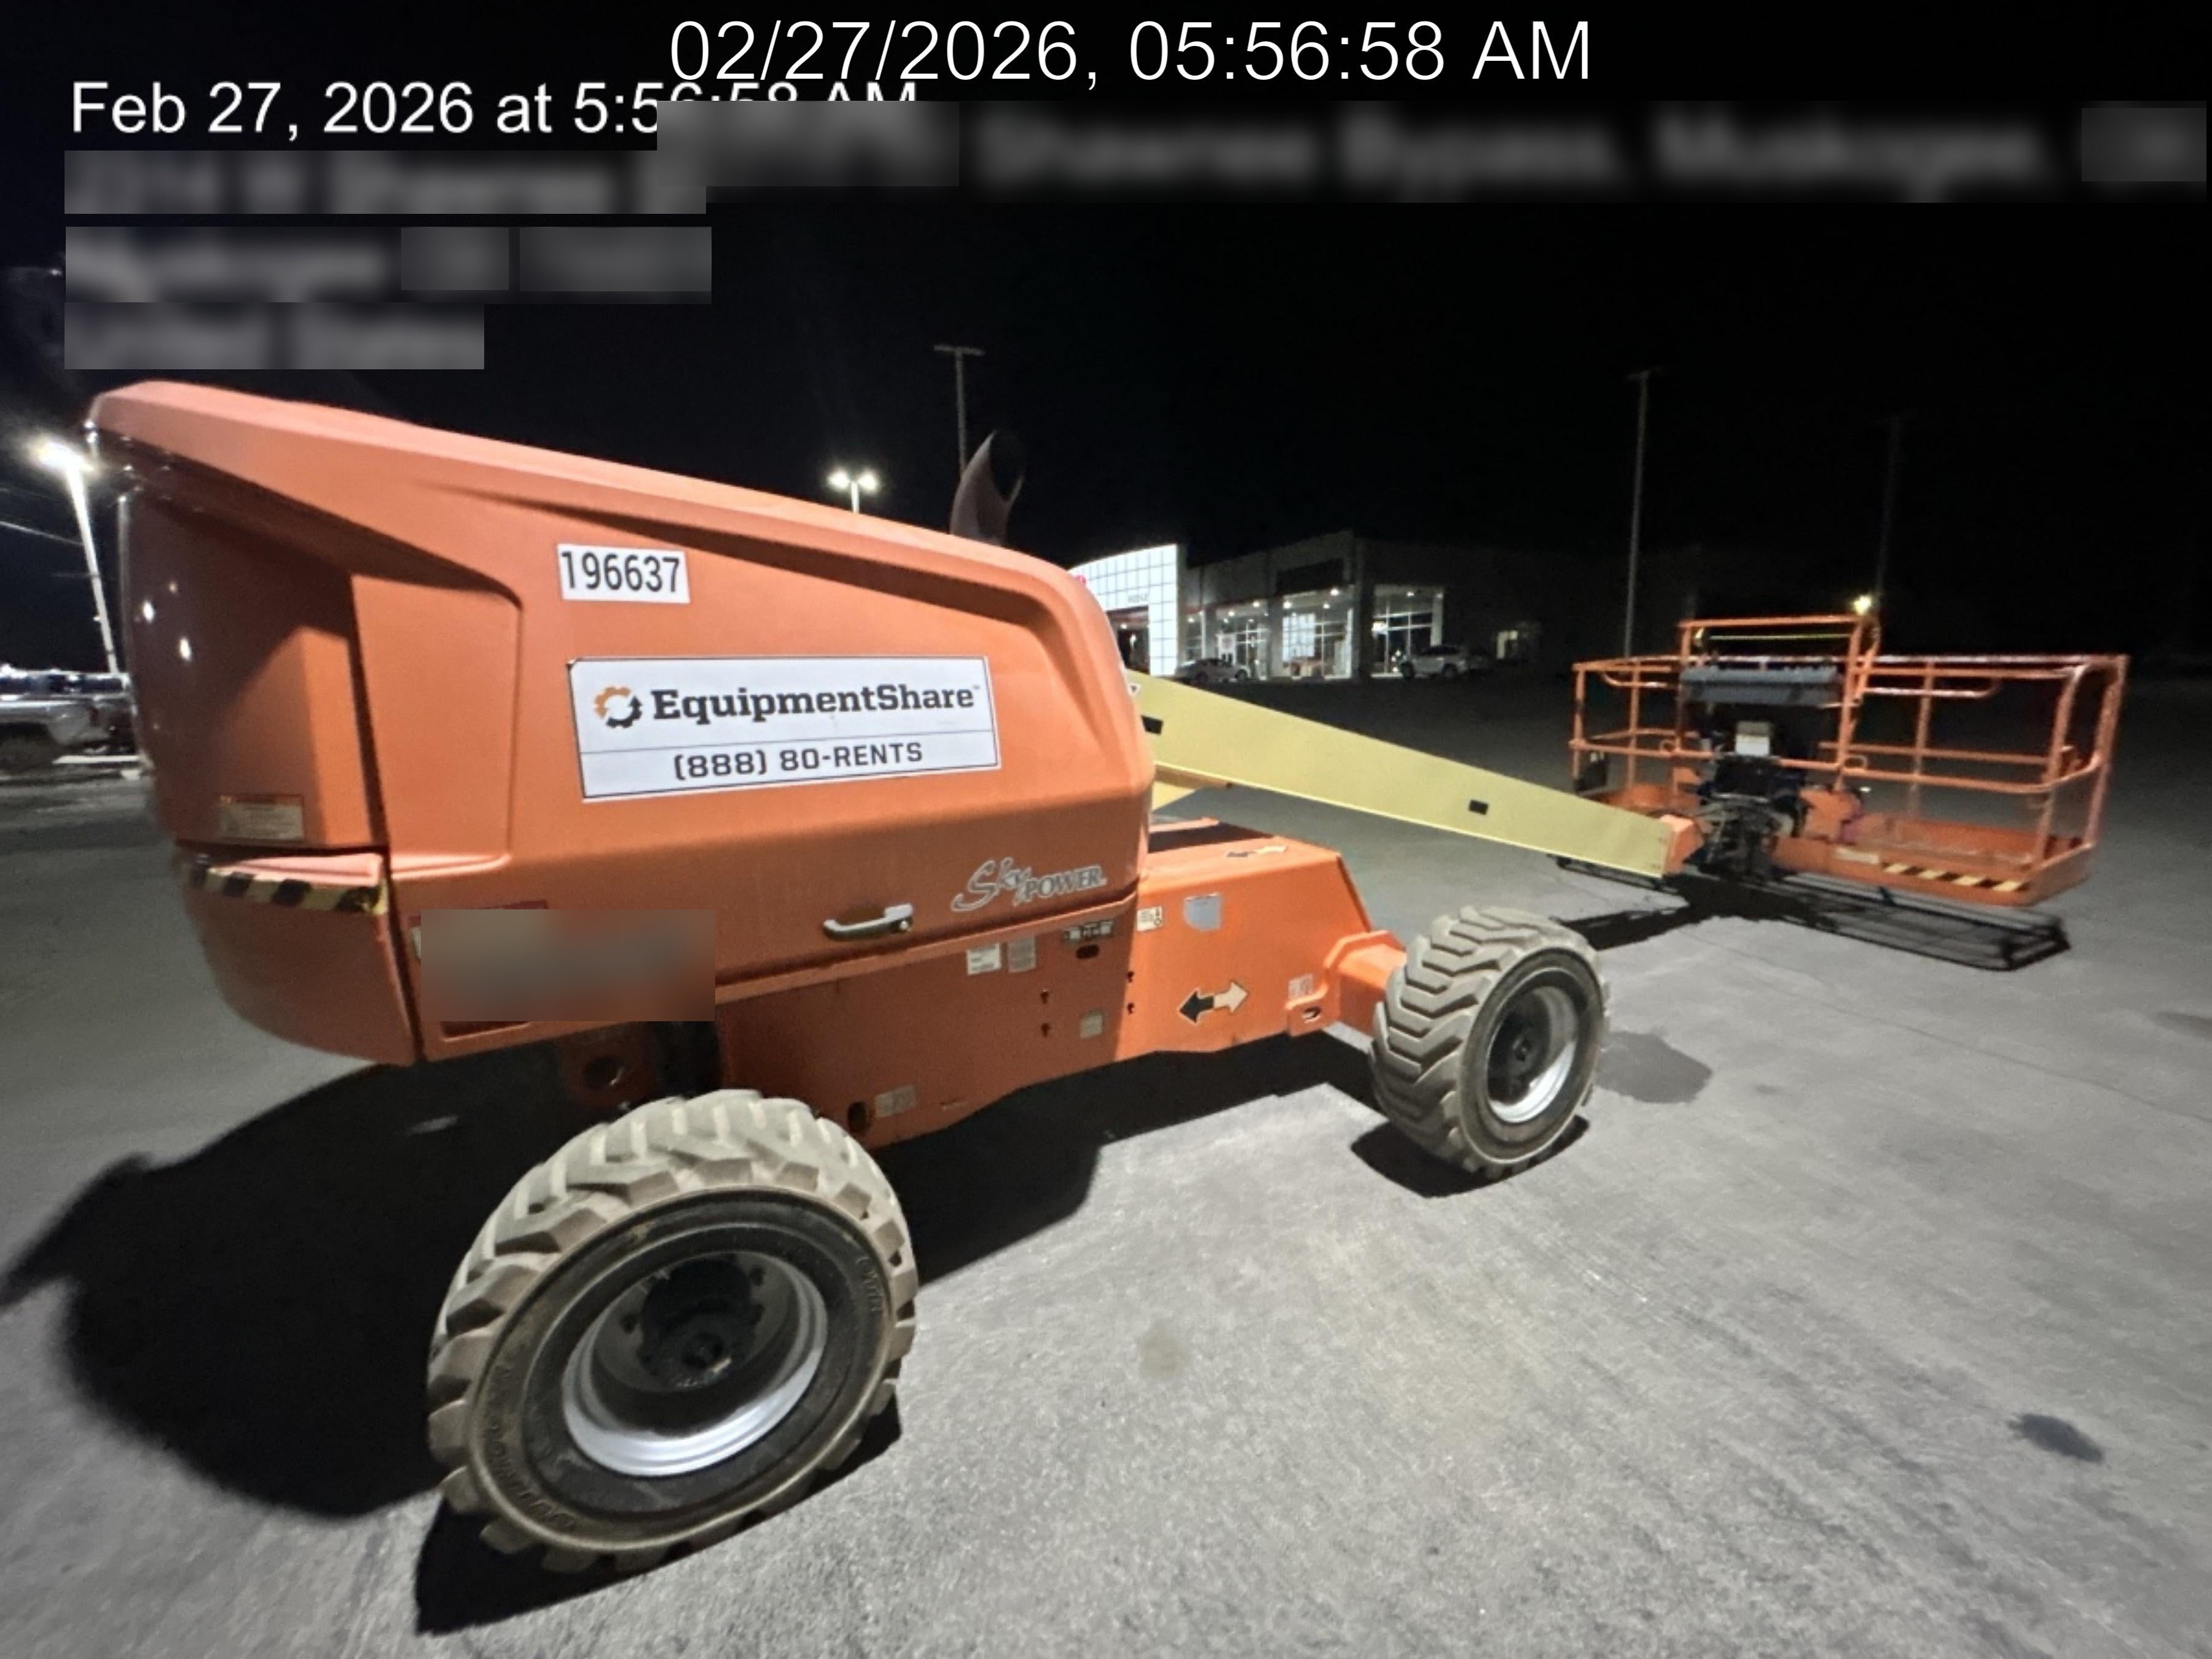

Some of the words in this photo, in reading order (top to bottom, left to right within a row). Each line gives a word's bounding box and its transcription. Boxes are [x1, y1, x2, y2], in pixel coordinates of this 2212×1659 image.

[562, 551, 680, 592] 196637
[651, 683, 975, 725] EquipmentShare
[673, 748, 767, 781] (888)
[780, 742, 924, 772] 80-RENTS
